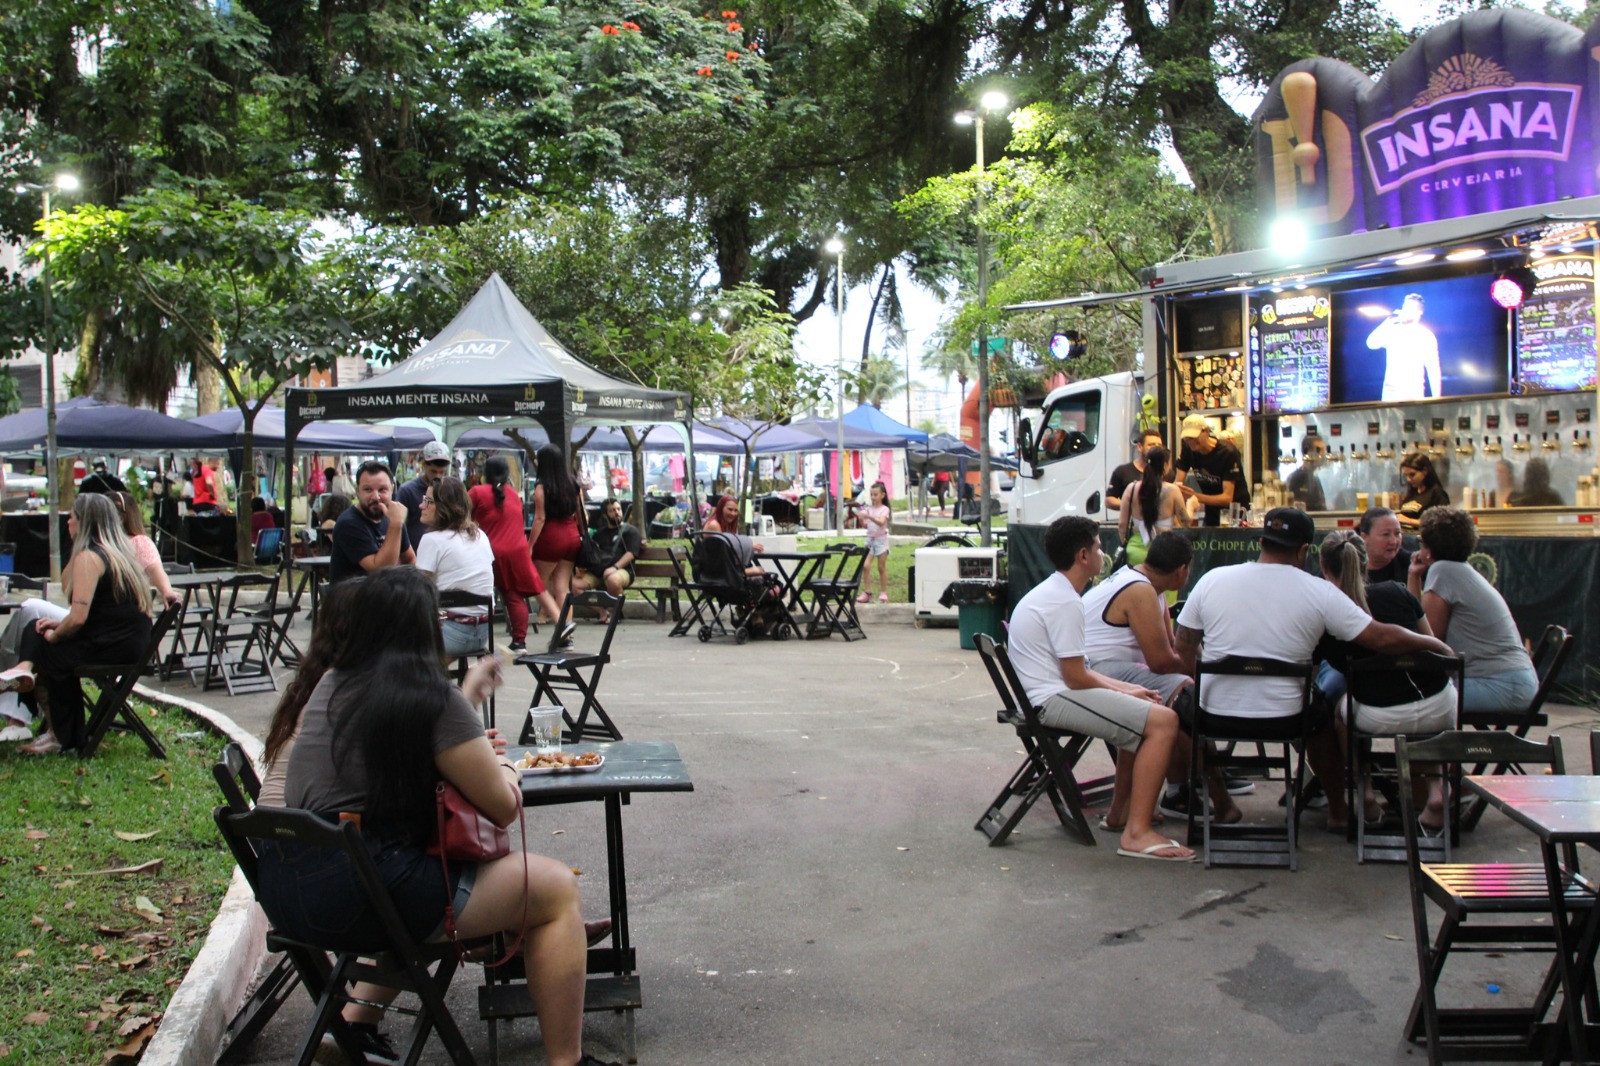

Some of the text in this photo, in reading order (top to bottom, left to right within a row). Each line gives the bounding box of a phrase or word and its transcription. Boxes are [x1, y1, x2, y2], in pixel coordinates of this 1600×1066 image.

[1377, 100, 1558, 173] INSANA
[1420, 166, 1523, 193] CERVEJARIA
[1530, 260, 1594, 280] NSANA
[413, 342, 497, 369] INSANA
[347, 392, 490, 407] INSANA MENTE INSANA
[514, 400, 546, 412] DICHOPP
[598, 395, 665, 410] INSANA MENTE INSANA
[298, 406, 327, 416] DICHOPP
[1209, 539, 1245, 552] CHOPE
